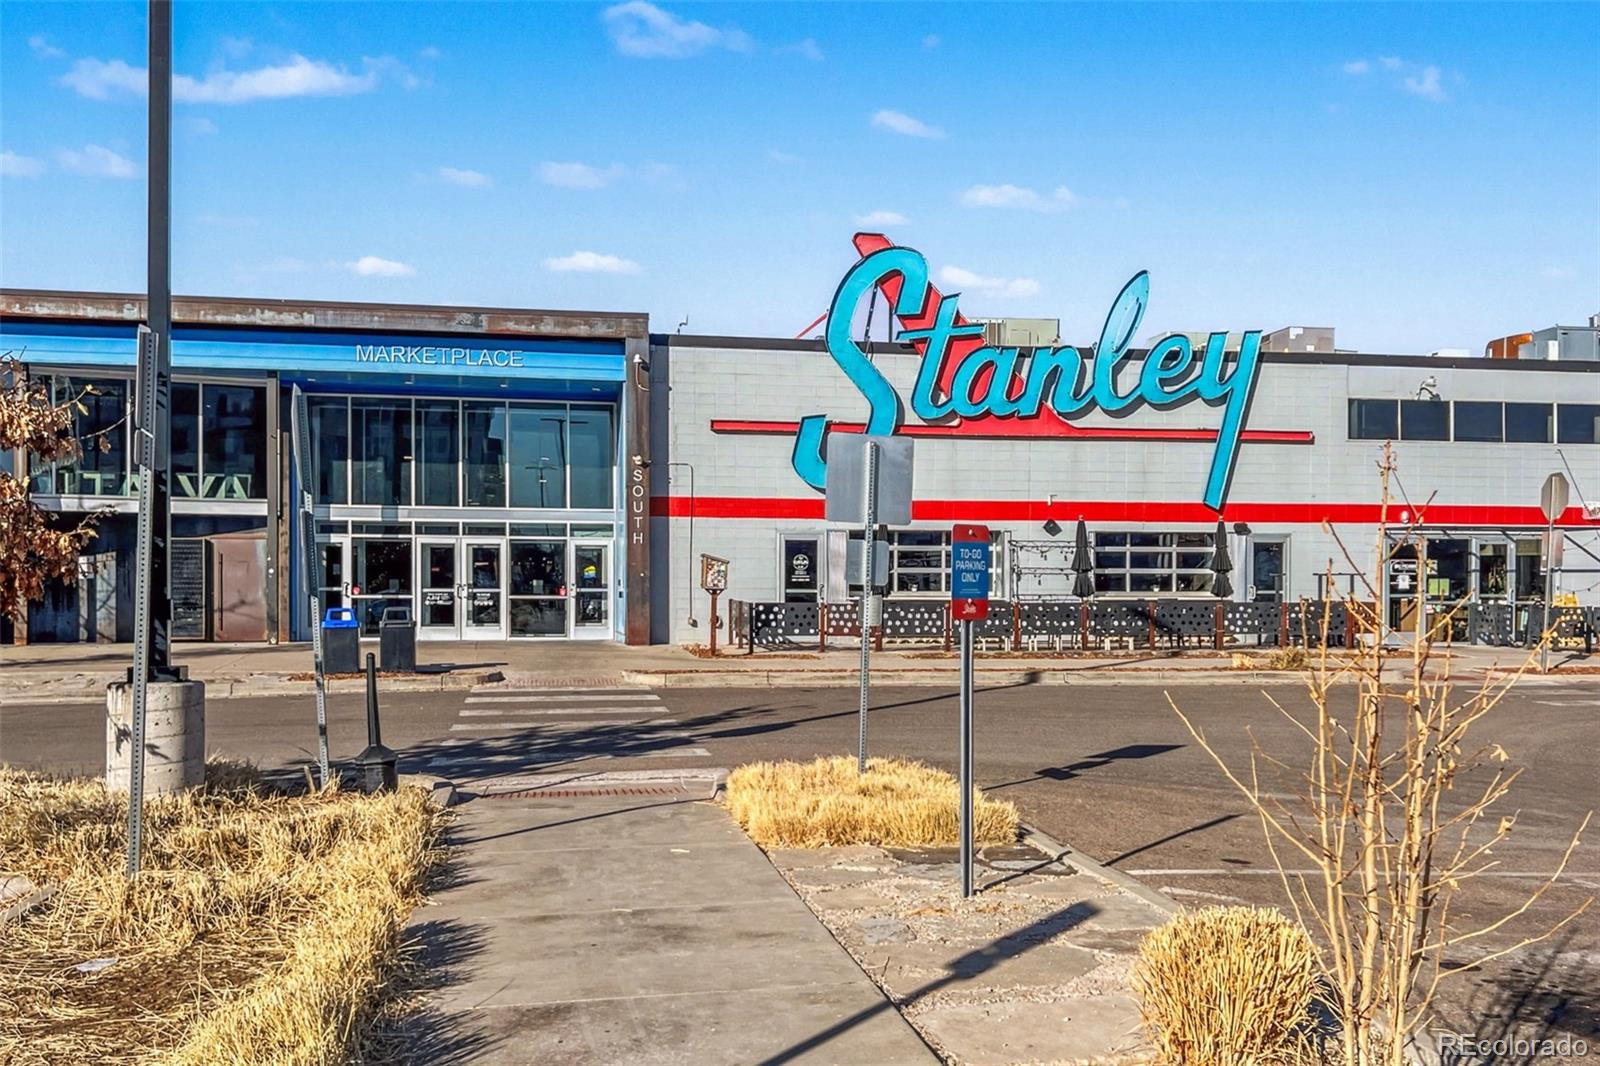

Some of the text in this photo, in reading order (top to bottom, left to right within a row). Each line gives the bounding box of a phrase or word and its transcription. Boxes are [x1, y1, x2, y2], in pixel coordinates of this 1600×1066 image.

[355, 344, 525, 367] MARKETPLACE
[791, 246, 1263, 509] Stanley
[632, 469, 644, 545] SOUTH
[960, 548, 982, 559] TO-GO
[955, 560, 986, 571] PARKING
[961, 572, 980, 583] ONLY
